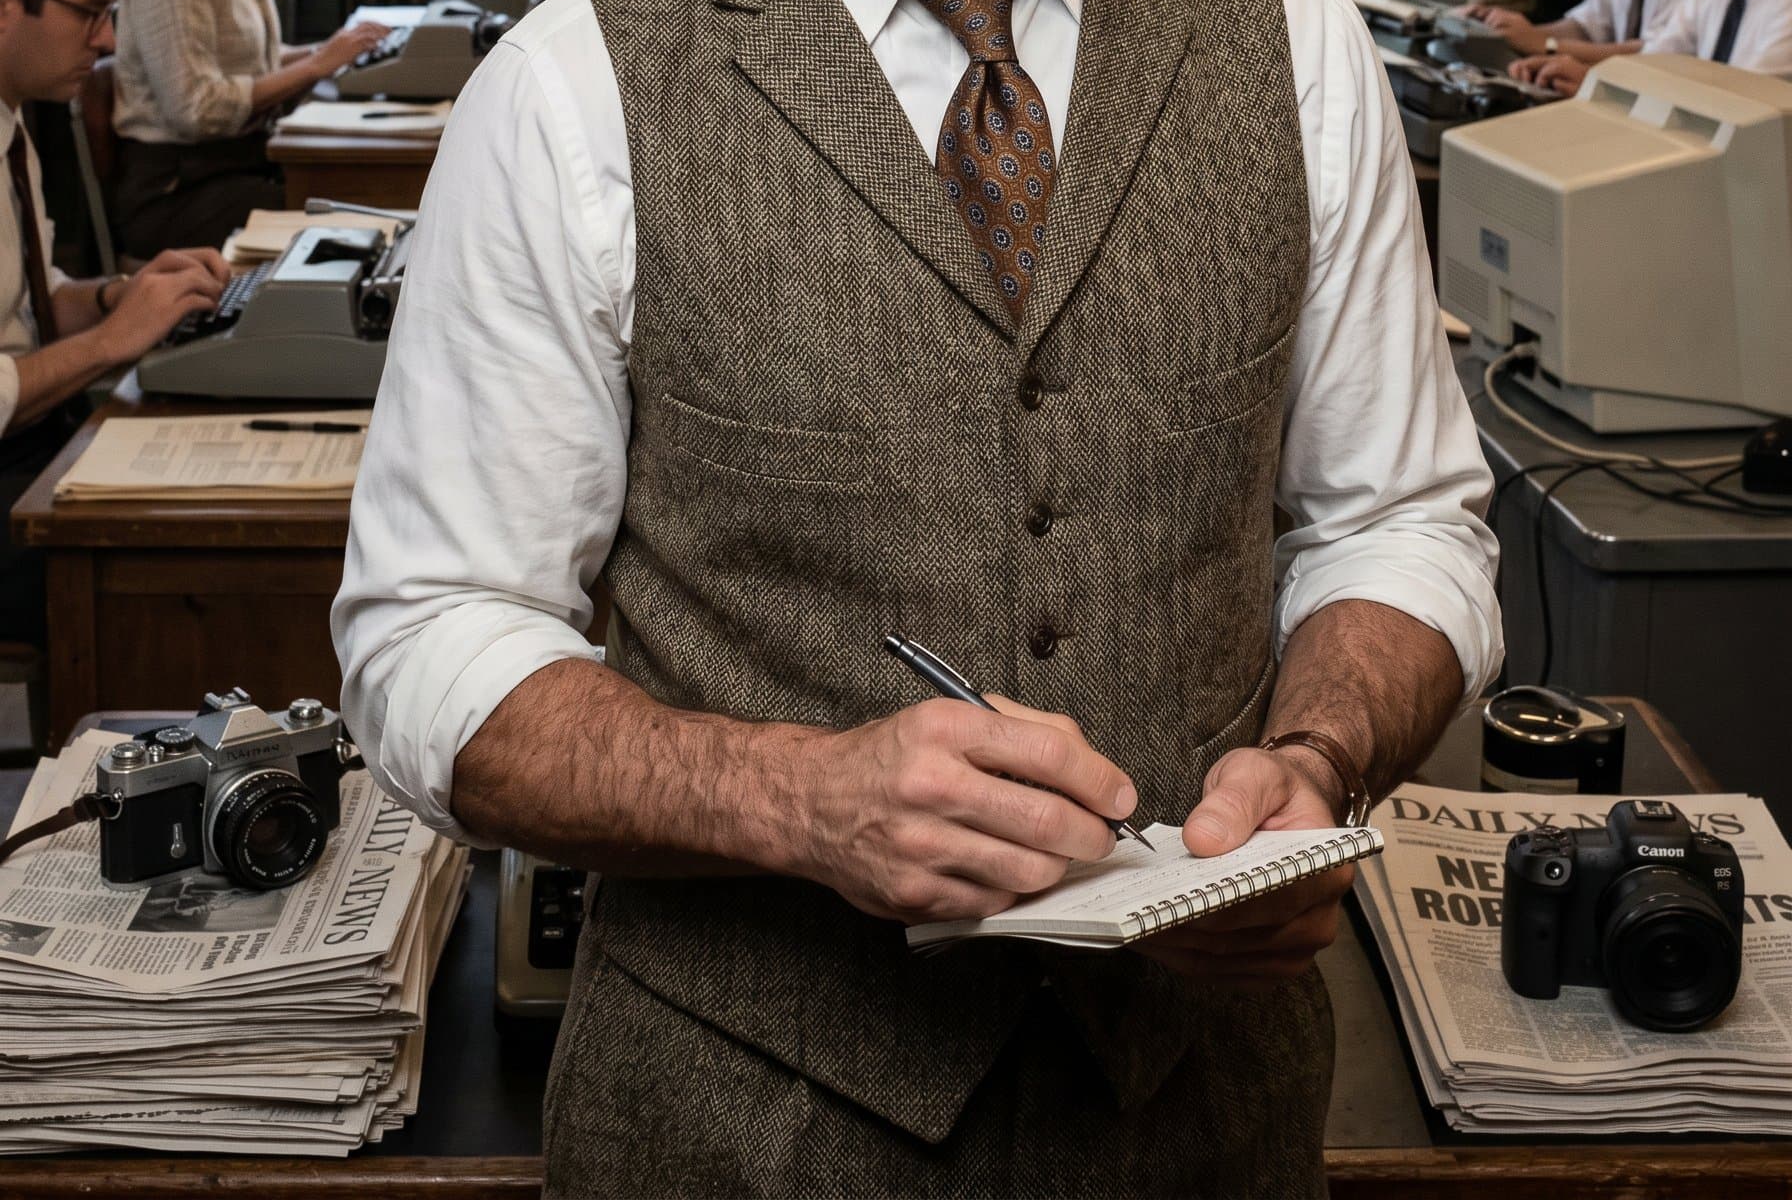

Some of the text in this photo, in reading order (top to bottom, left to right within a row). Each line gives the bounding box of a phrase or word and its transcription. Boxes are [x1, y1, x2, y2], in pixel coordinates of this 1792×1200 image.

[1389, 797, 1555, 834] DAILY
[1637, 845, 1685, 858] Canon
[323, 795, 414, 946] AILY NEWS
[1436, 855, 1506, 893] NE
[1713, 867, 1732, 878] EOS
